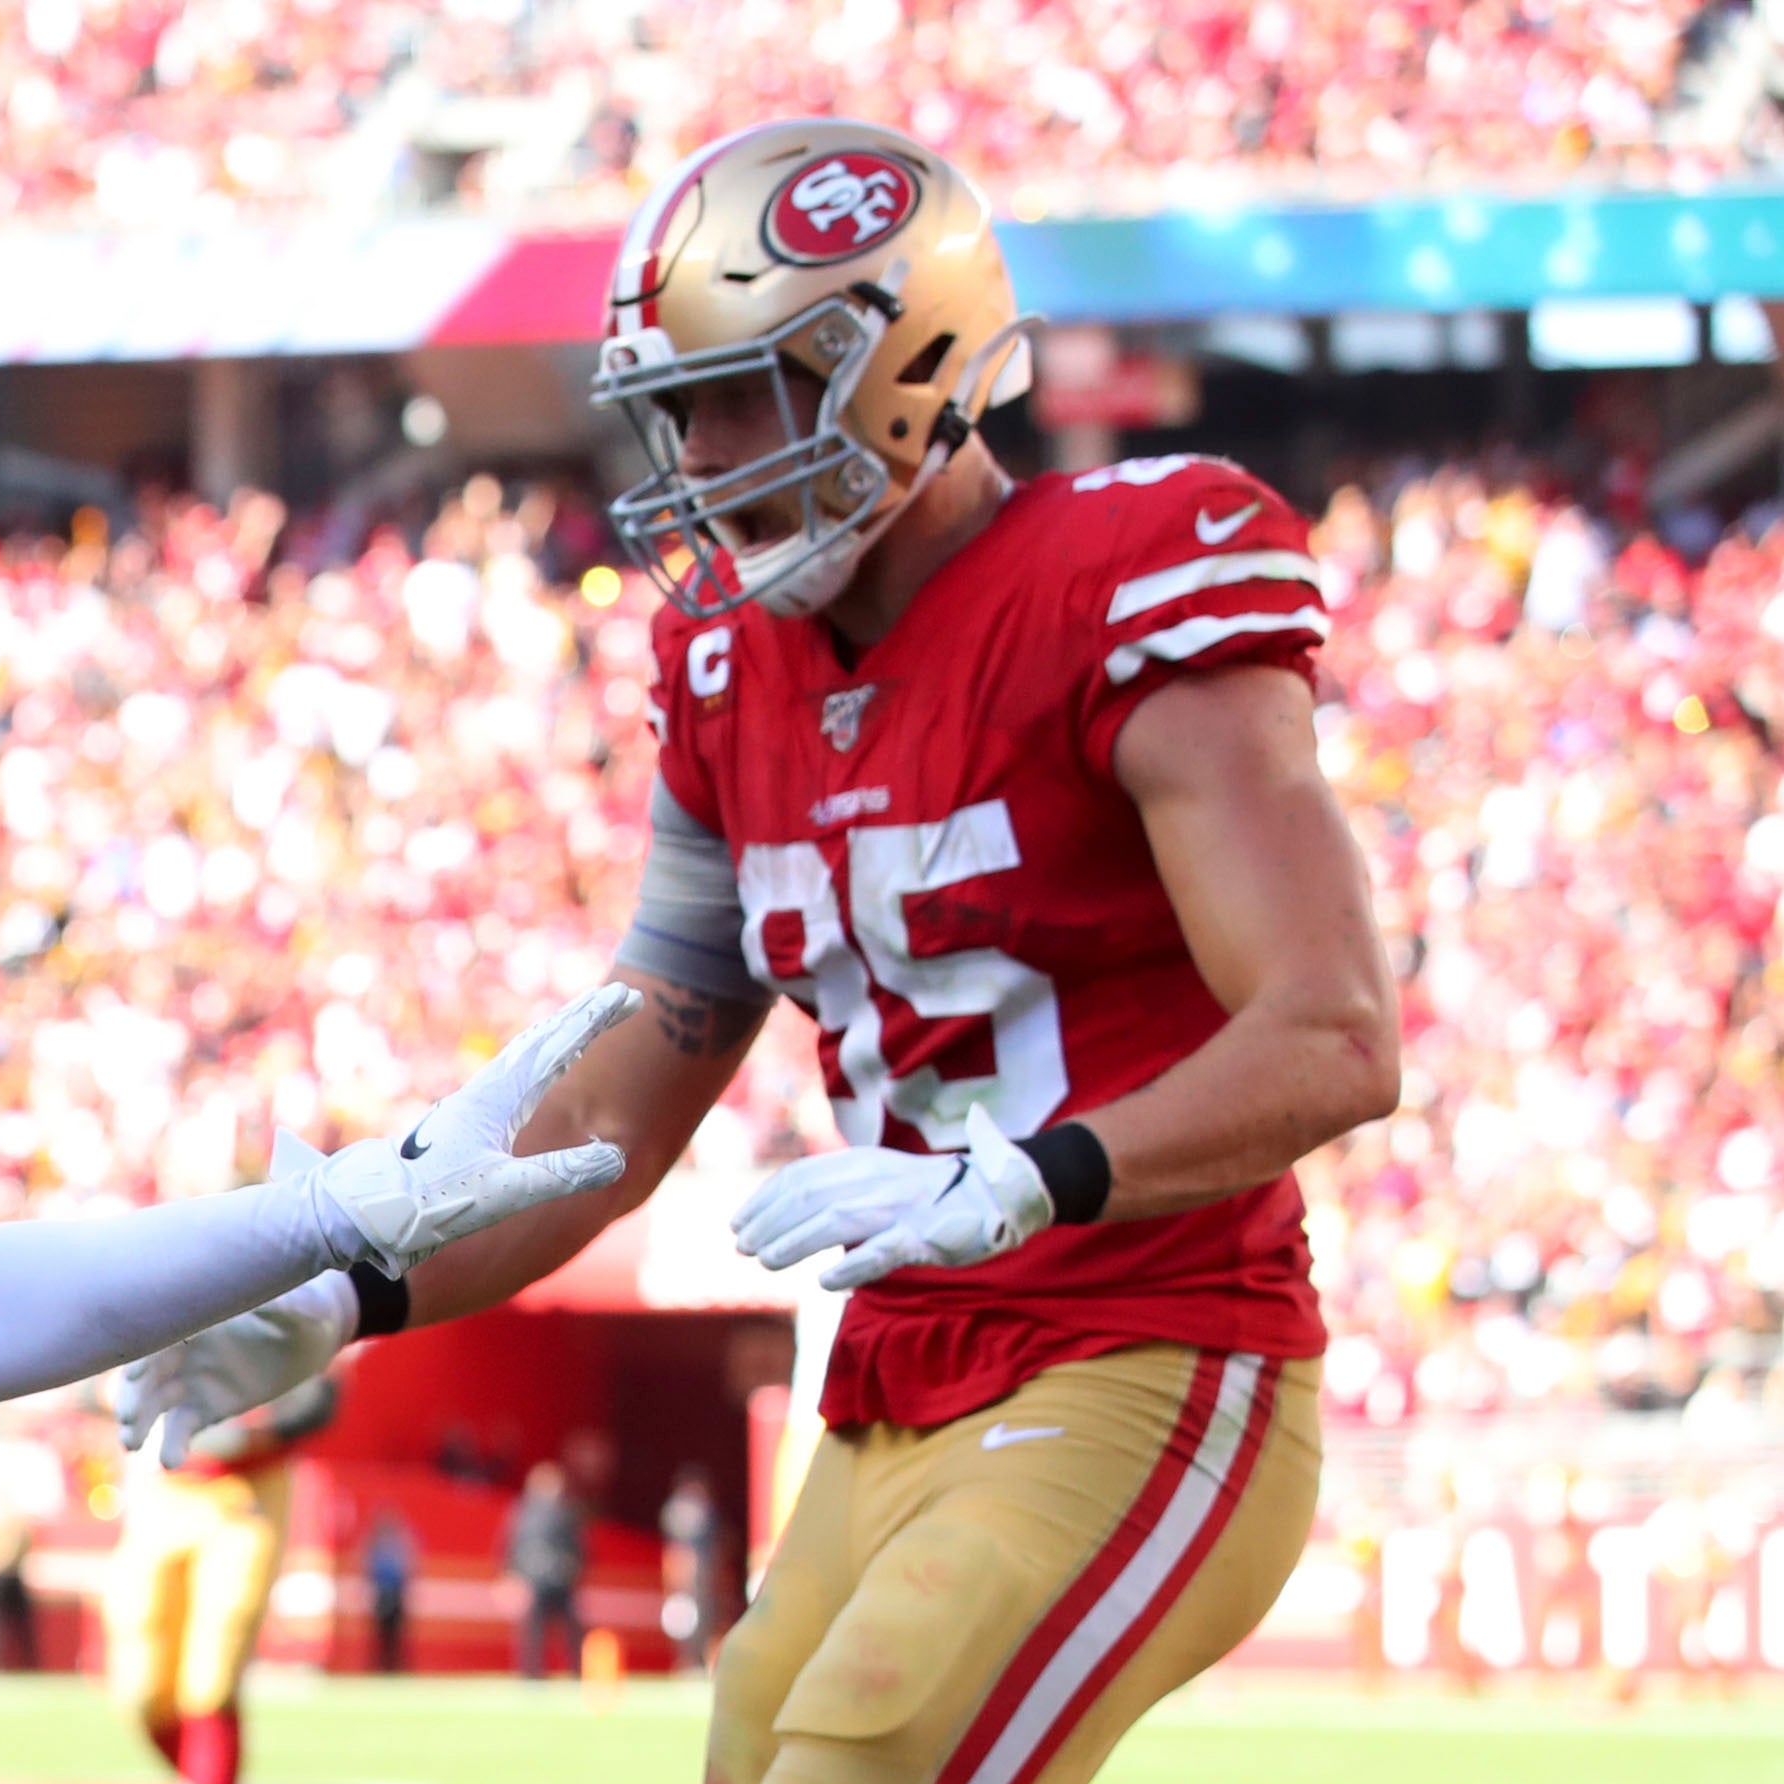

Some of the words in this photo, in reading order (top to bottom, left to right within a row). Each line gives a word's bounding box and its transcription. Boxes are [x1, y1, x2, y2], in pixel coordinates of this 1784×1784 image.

[790, 160, 900, 244] SF
[687, 626, 732, 698] C
[737, 799, 1070, 1153] 95
